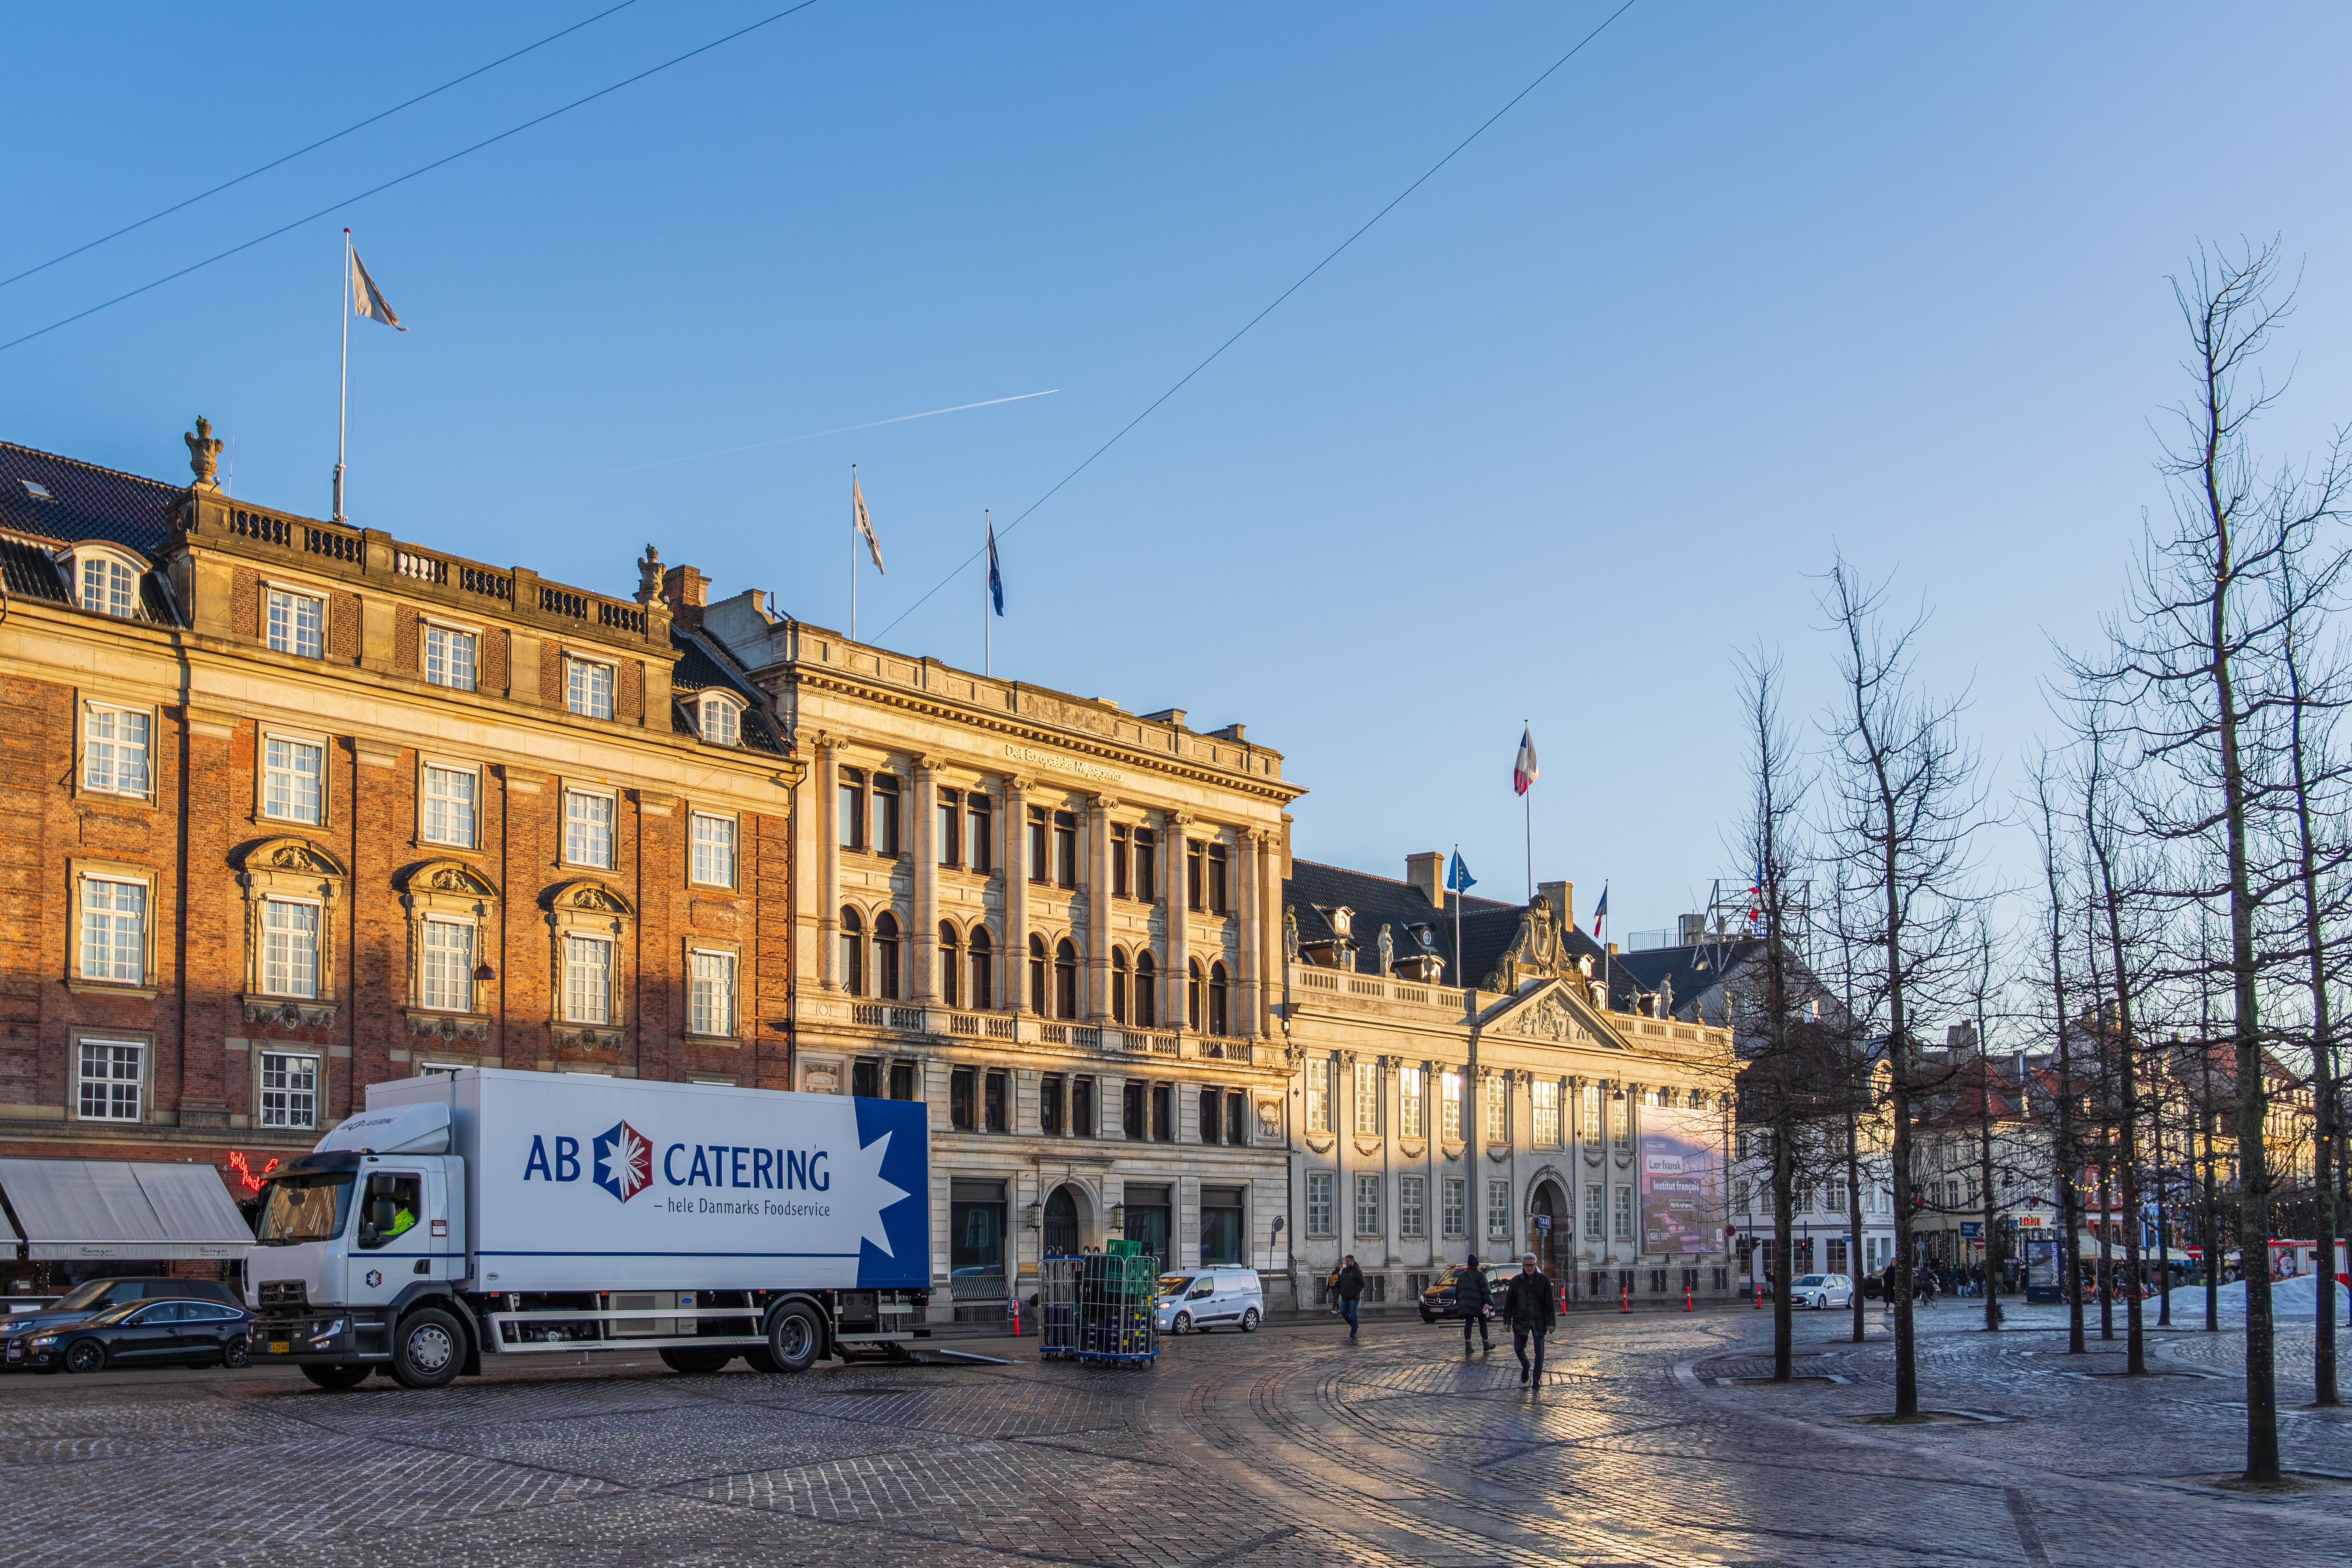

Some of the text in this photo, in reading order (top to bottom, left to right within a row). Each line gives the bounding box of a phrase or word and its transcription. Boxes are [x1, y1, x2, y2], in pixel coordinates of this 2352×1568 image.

[1007, 744, 1125, 782] Det Europæiske Miljøagentur
[361, 1117, 397, 1127] CATERING
[523, 1134, 830, 1192] AB CATERING
[1649, 1159, 1661, 1170] Lær
[1662, 1160, 1681, 1171] fransk
[1653, 1180, 1699, 1194] Institut français
[668, 1196, 694, 1213] hele
[699, 1198, 759, 1215] Danmarks
[764, 1200, 830, 1217] Foodservice
[81, 1247, 113, 1257] Ravage
[199, 1247, 228, 1256] Ravage
